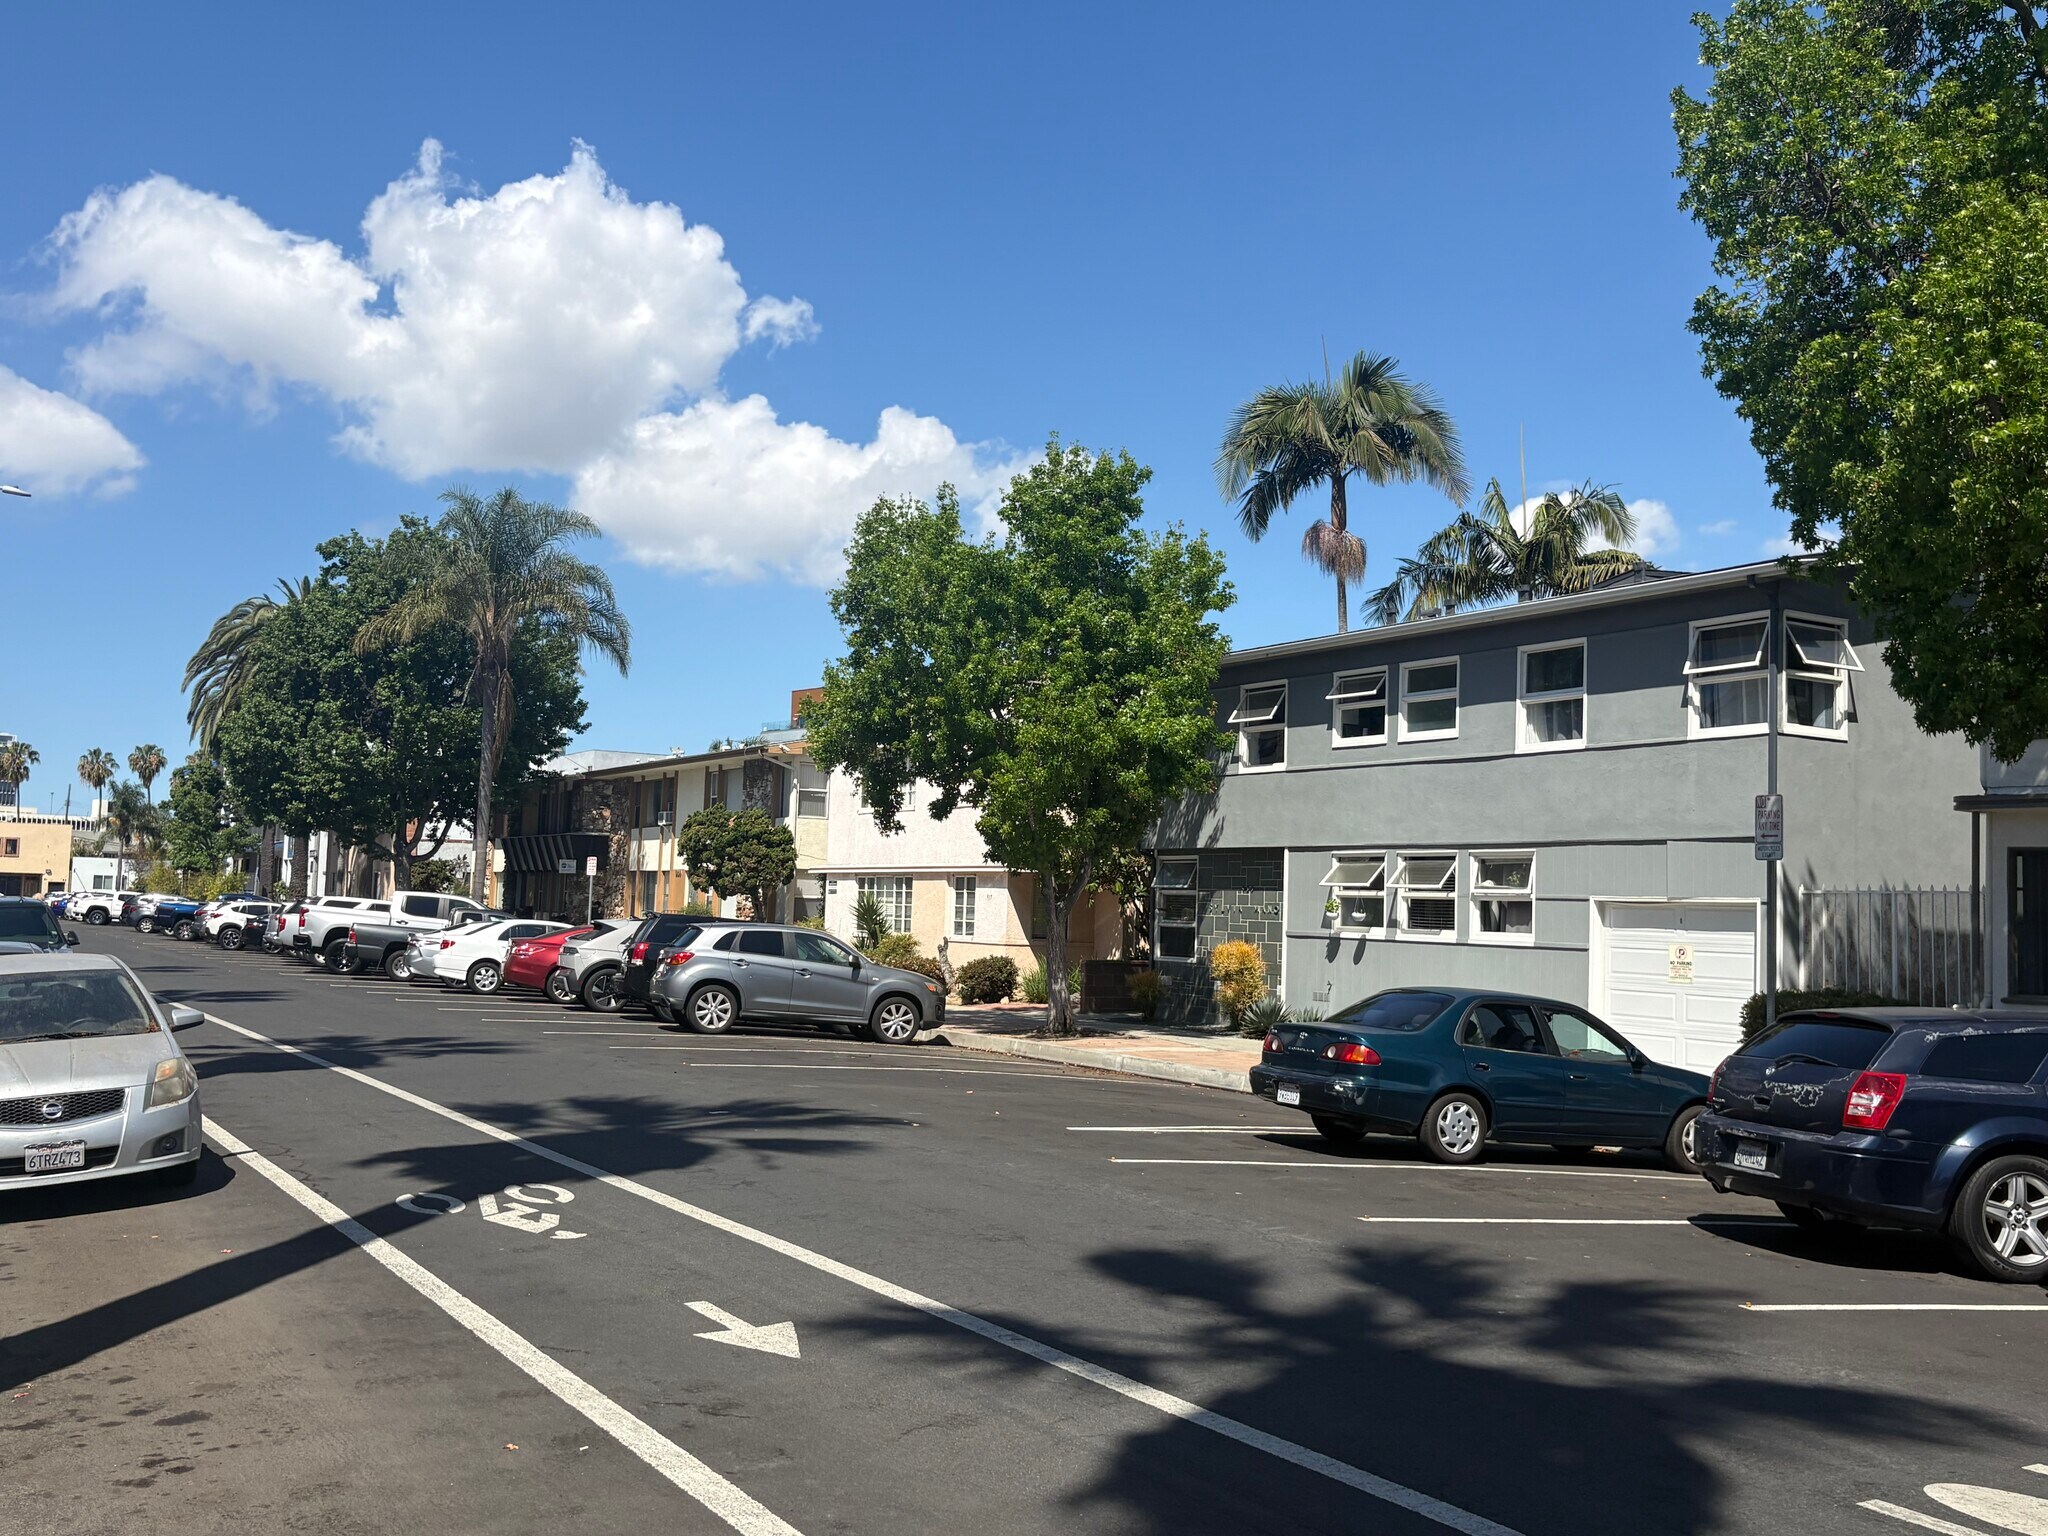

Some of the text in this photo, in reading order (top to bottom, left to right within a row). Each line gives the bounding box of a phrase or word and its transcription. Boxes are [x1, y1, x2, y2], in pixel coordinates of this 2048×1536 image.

[1757, 796, 1766, 808] NO
[1758, 810, 1780, 819] PARKING
[1758, 821, 1780, 831] ANY TIME
[29, 1151, 81, 1169] 6TRZ473
